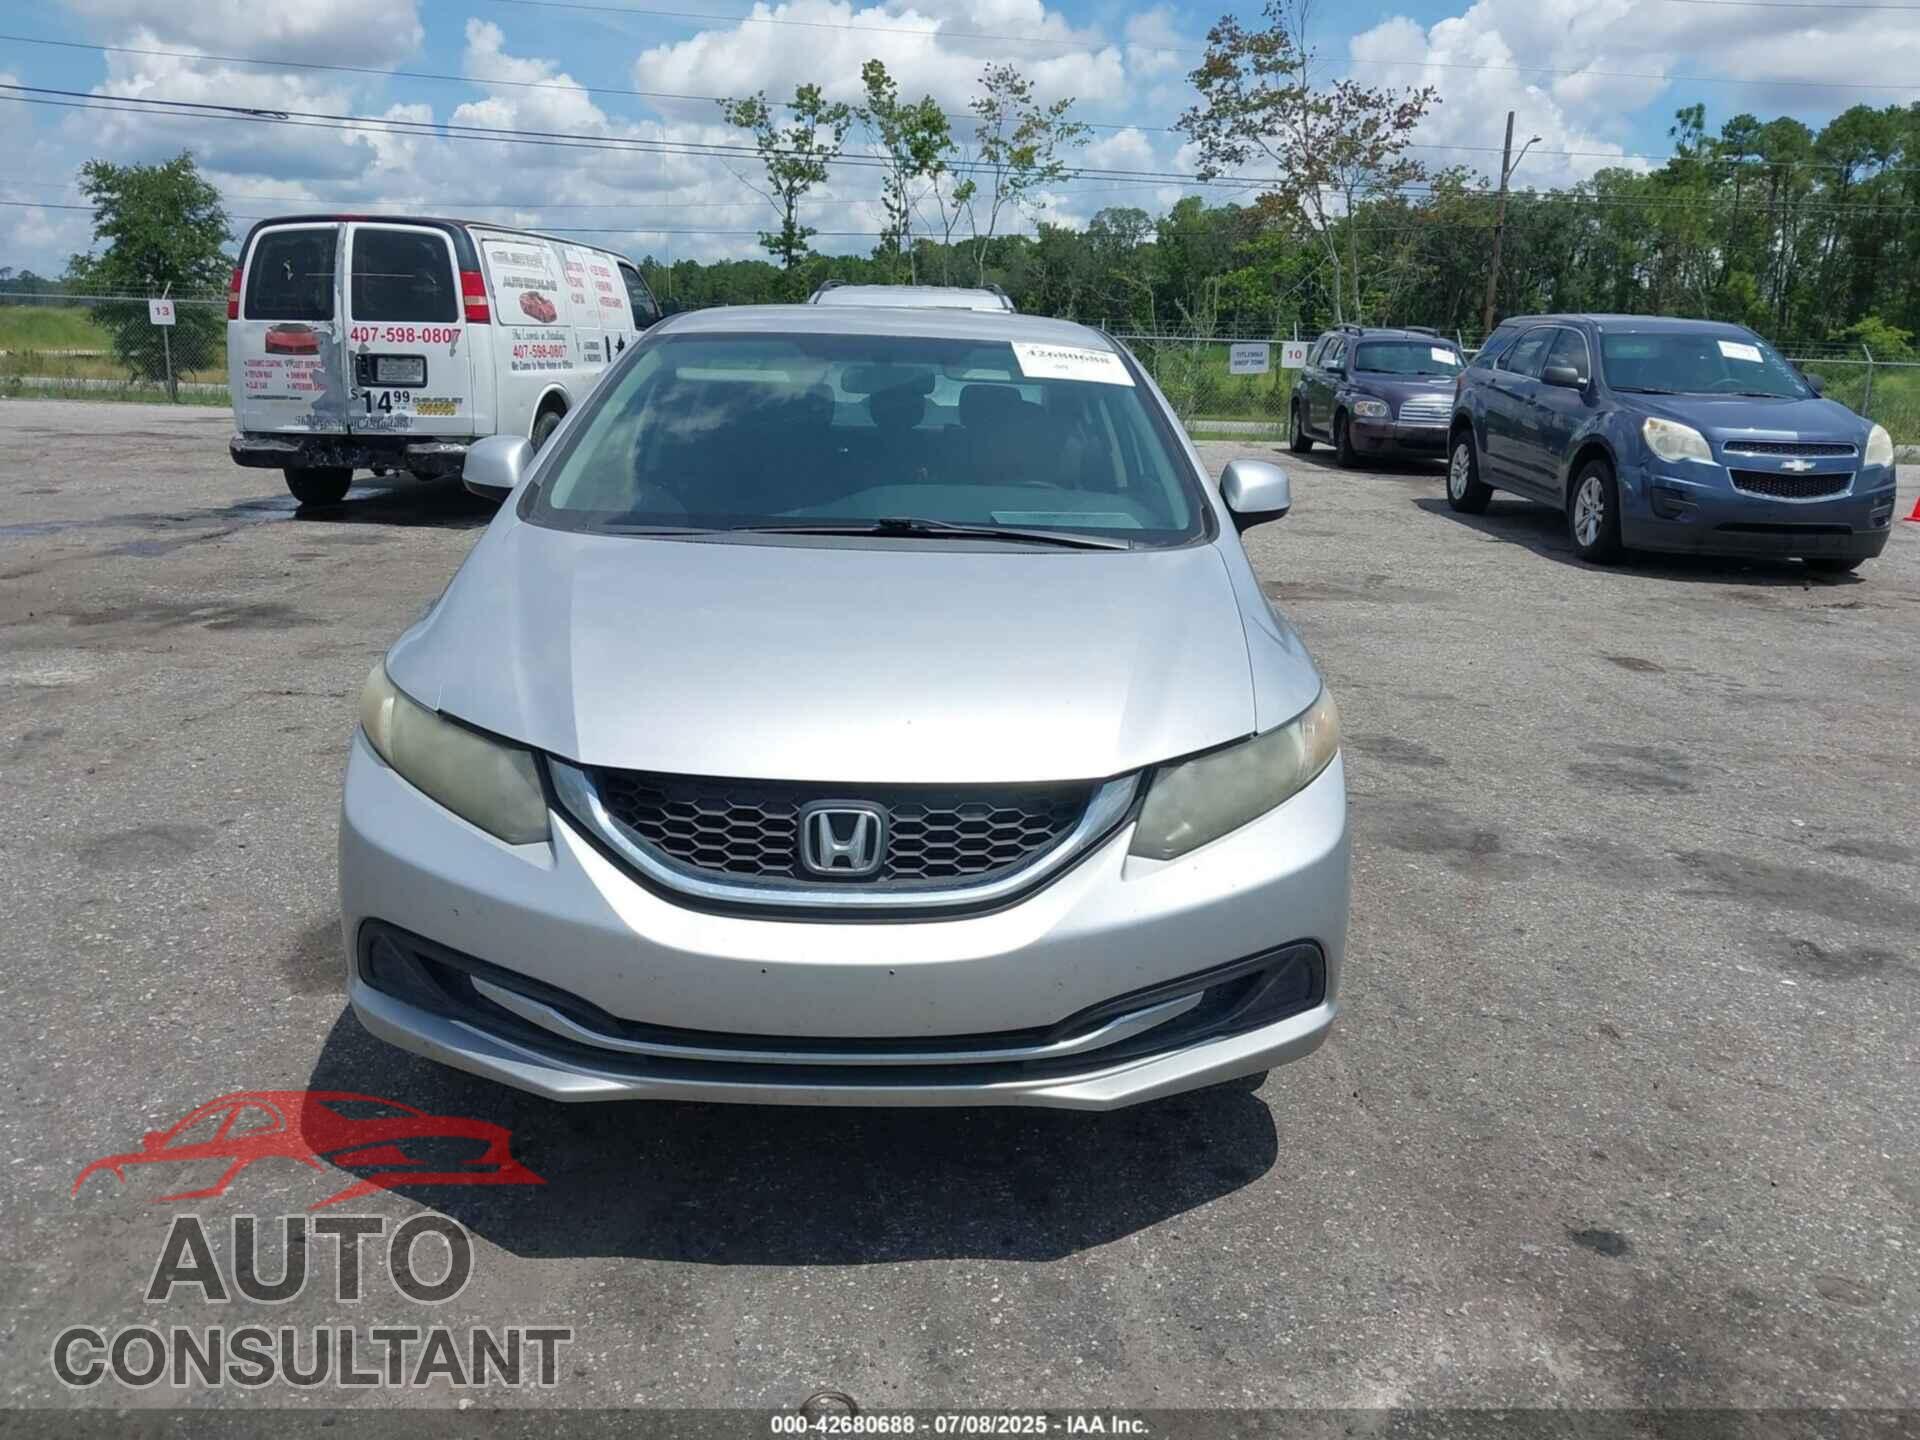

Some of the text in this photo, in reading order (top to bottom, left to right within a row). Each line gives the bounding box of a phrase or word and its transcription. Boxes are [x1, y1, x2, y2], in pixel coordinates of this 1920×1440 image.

[350, 326, 461, 343] 407-598-0807
[512, 343, 567, 358] 407-598-0807
[1287, 350, 1303, 360] 10
